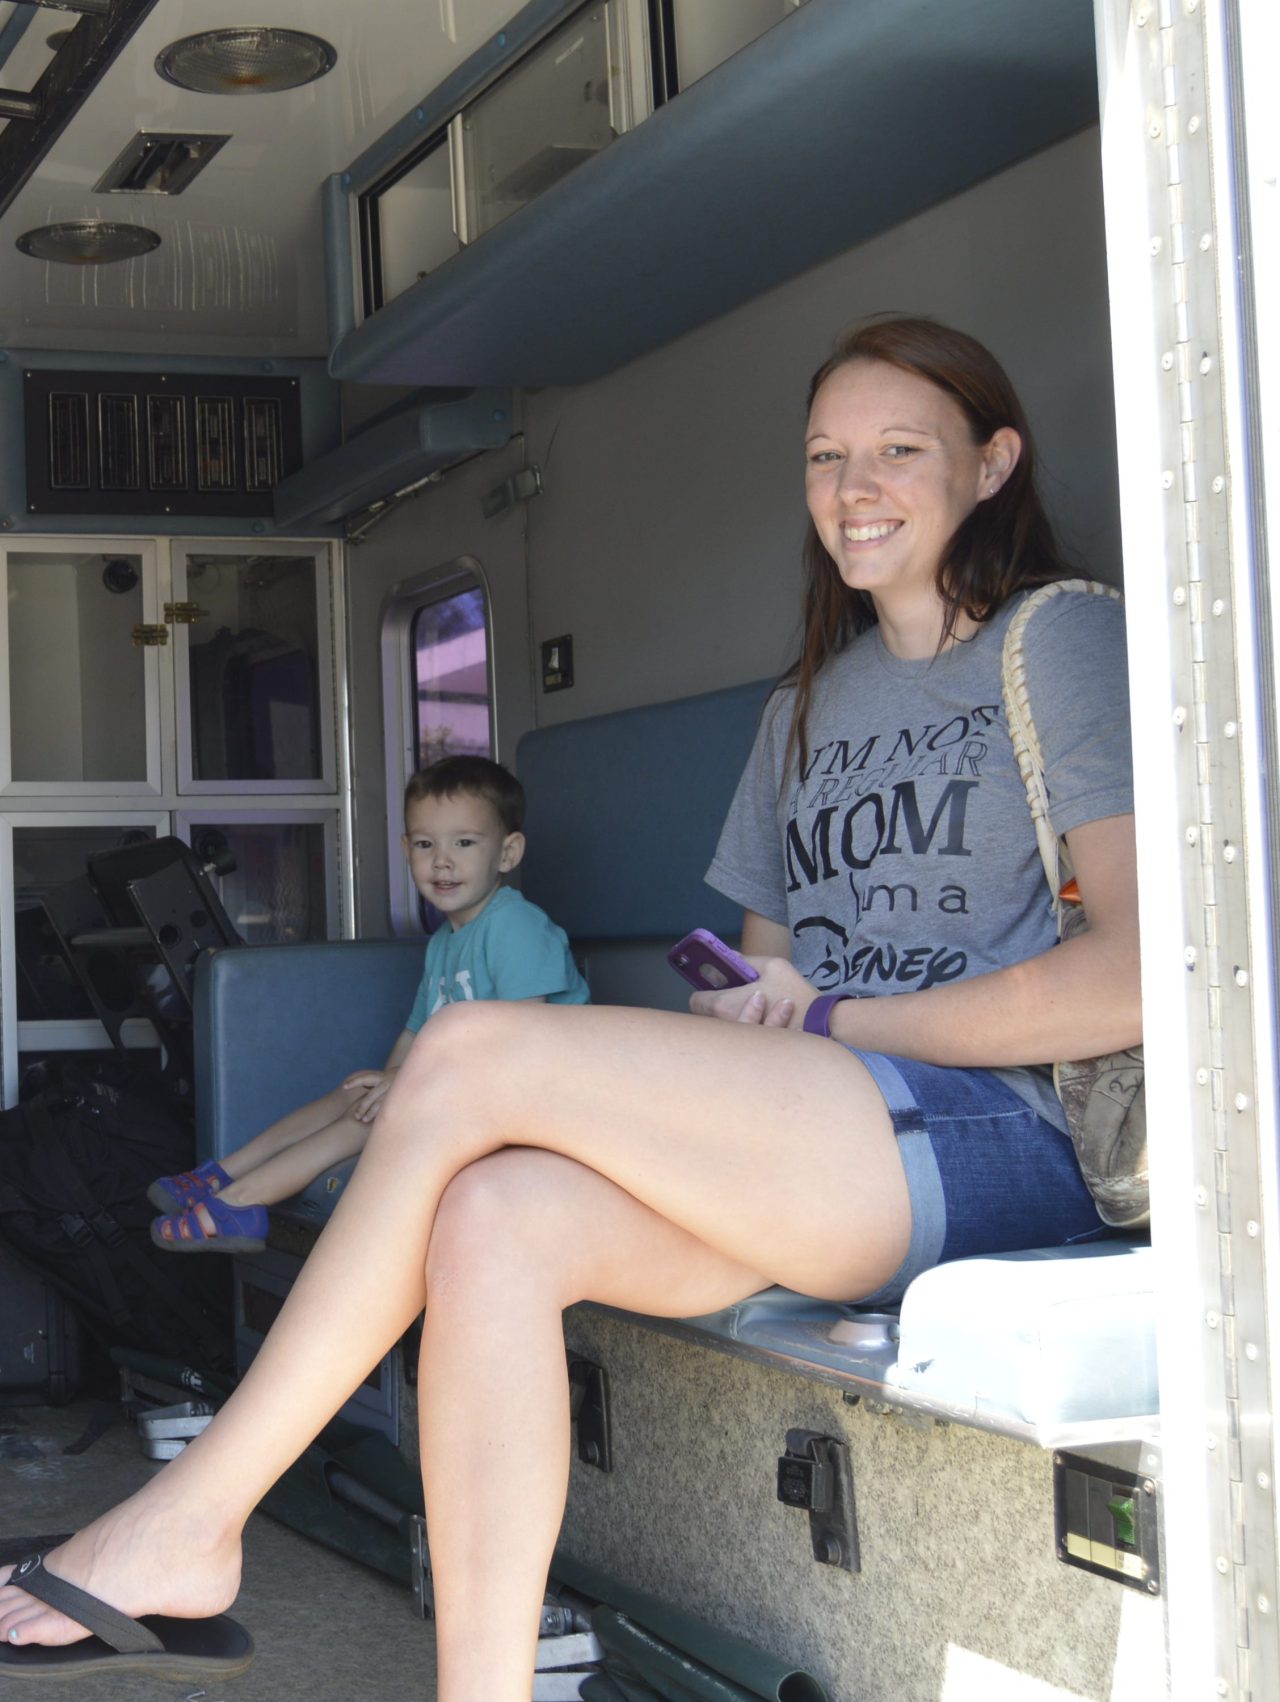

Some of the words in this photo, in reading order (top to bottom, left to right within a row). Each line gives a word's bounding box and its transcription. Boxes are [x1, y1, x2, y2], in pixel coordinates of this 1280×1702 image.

[883, 705, 1000, 764] NOT
[786, 779, 979, 893] MOM
[938, 885, 969, 914] a
